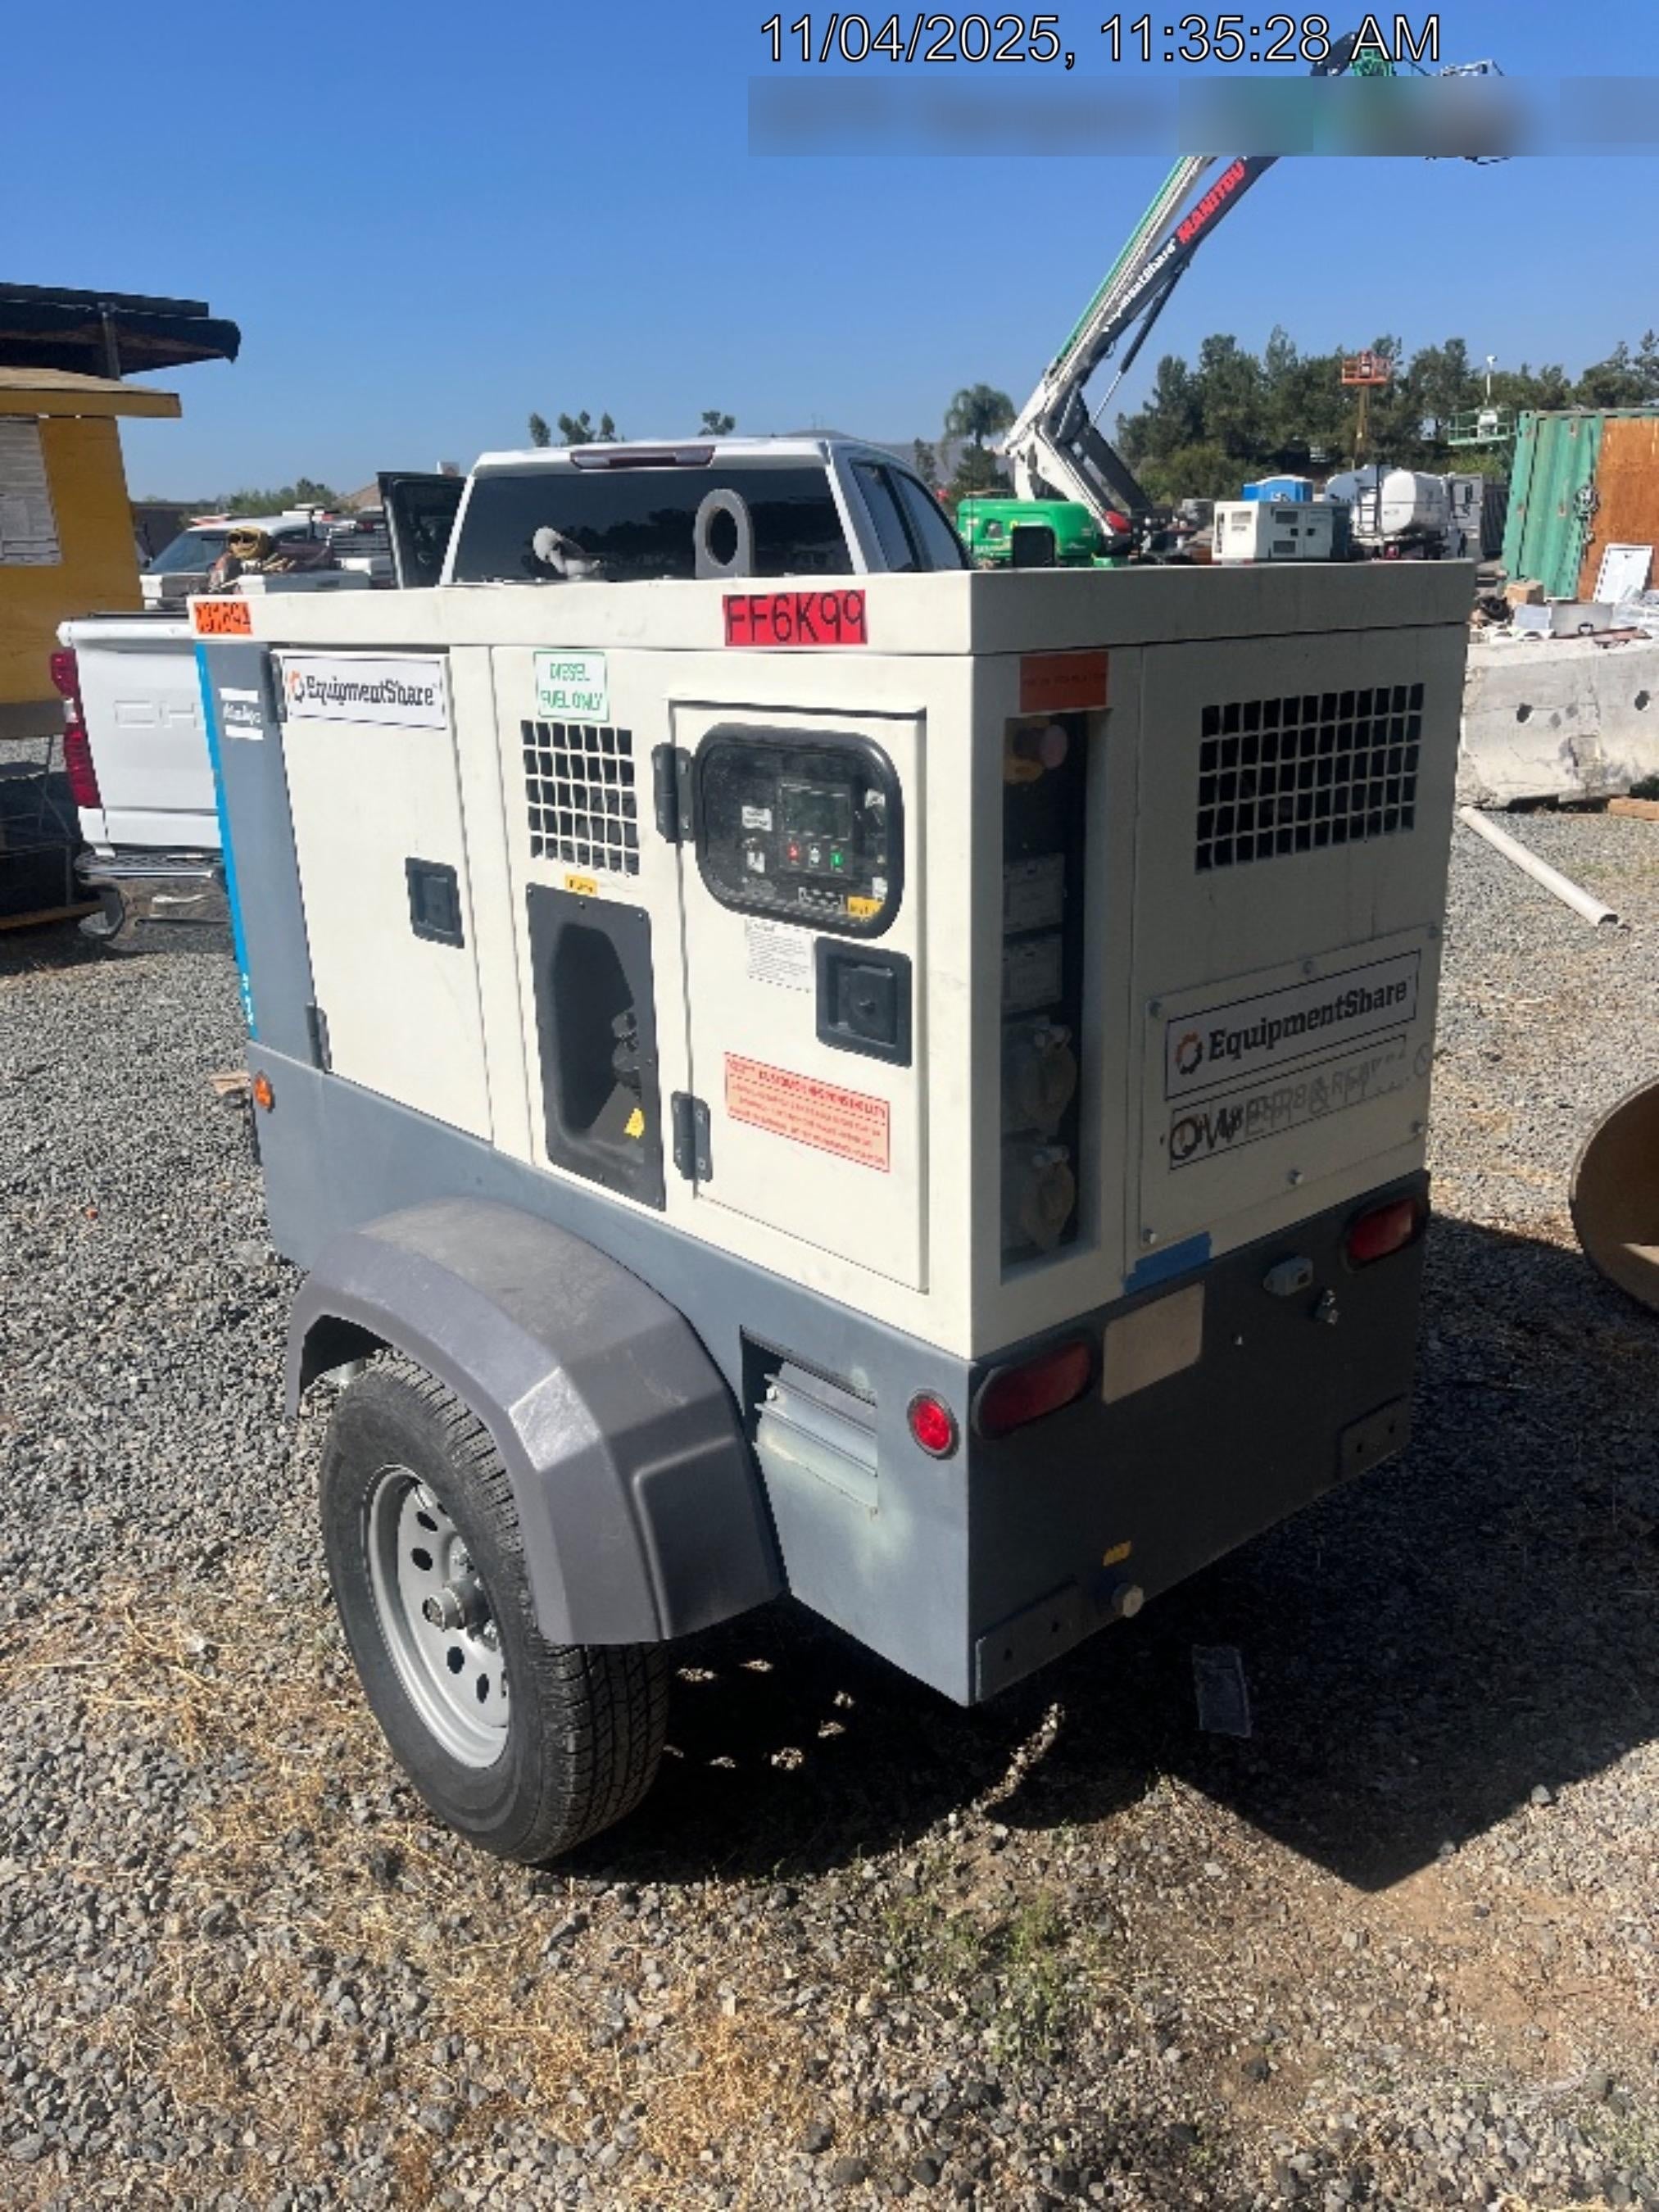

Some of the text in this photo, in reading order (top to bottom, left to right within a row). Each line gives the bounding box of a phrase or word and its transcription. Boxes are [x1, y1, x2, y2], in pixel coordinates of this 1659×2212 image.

[727, 589, 866, 643] FF6K99
[306, 666, 435, 706] EquipmentShare
[1208, 980, 1408, 1063] EquipmentShare
